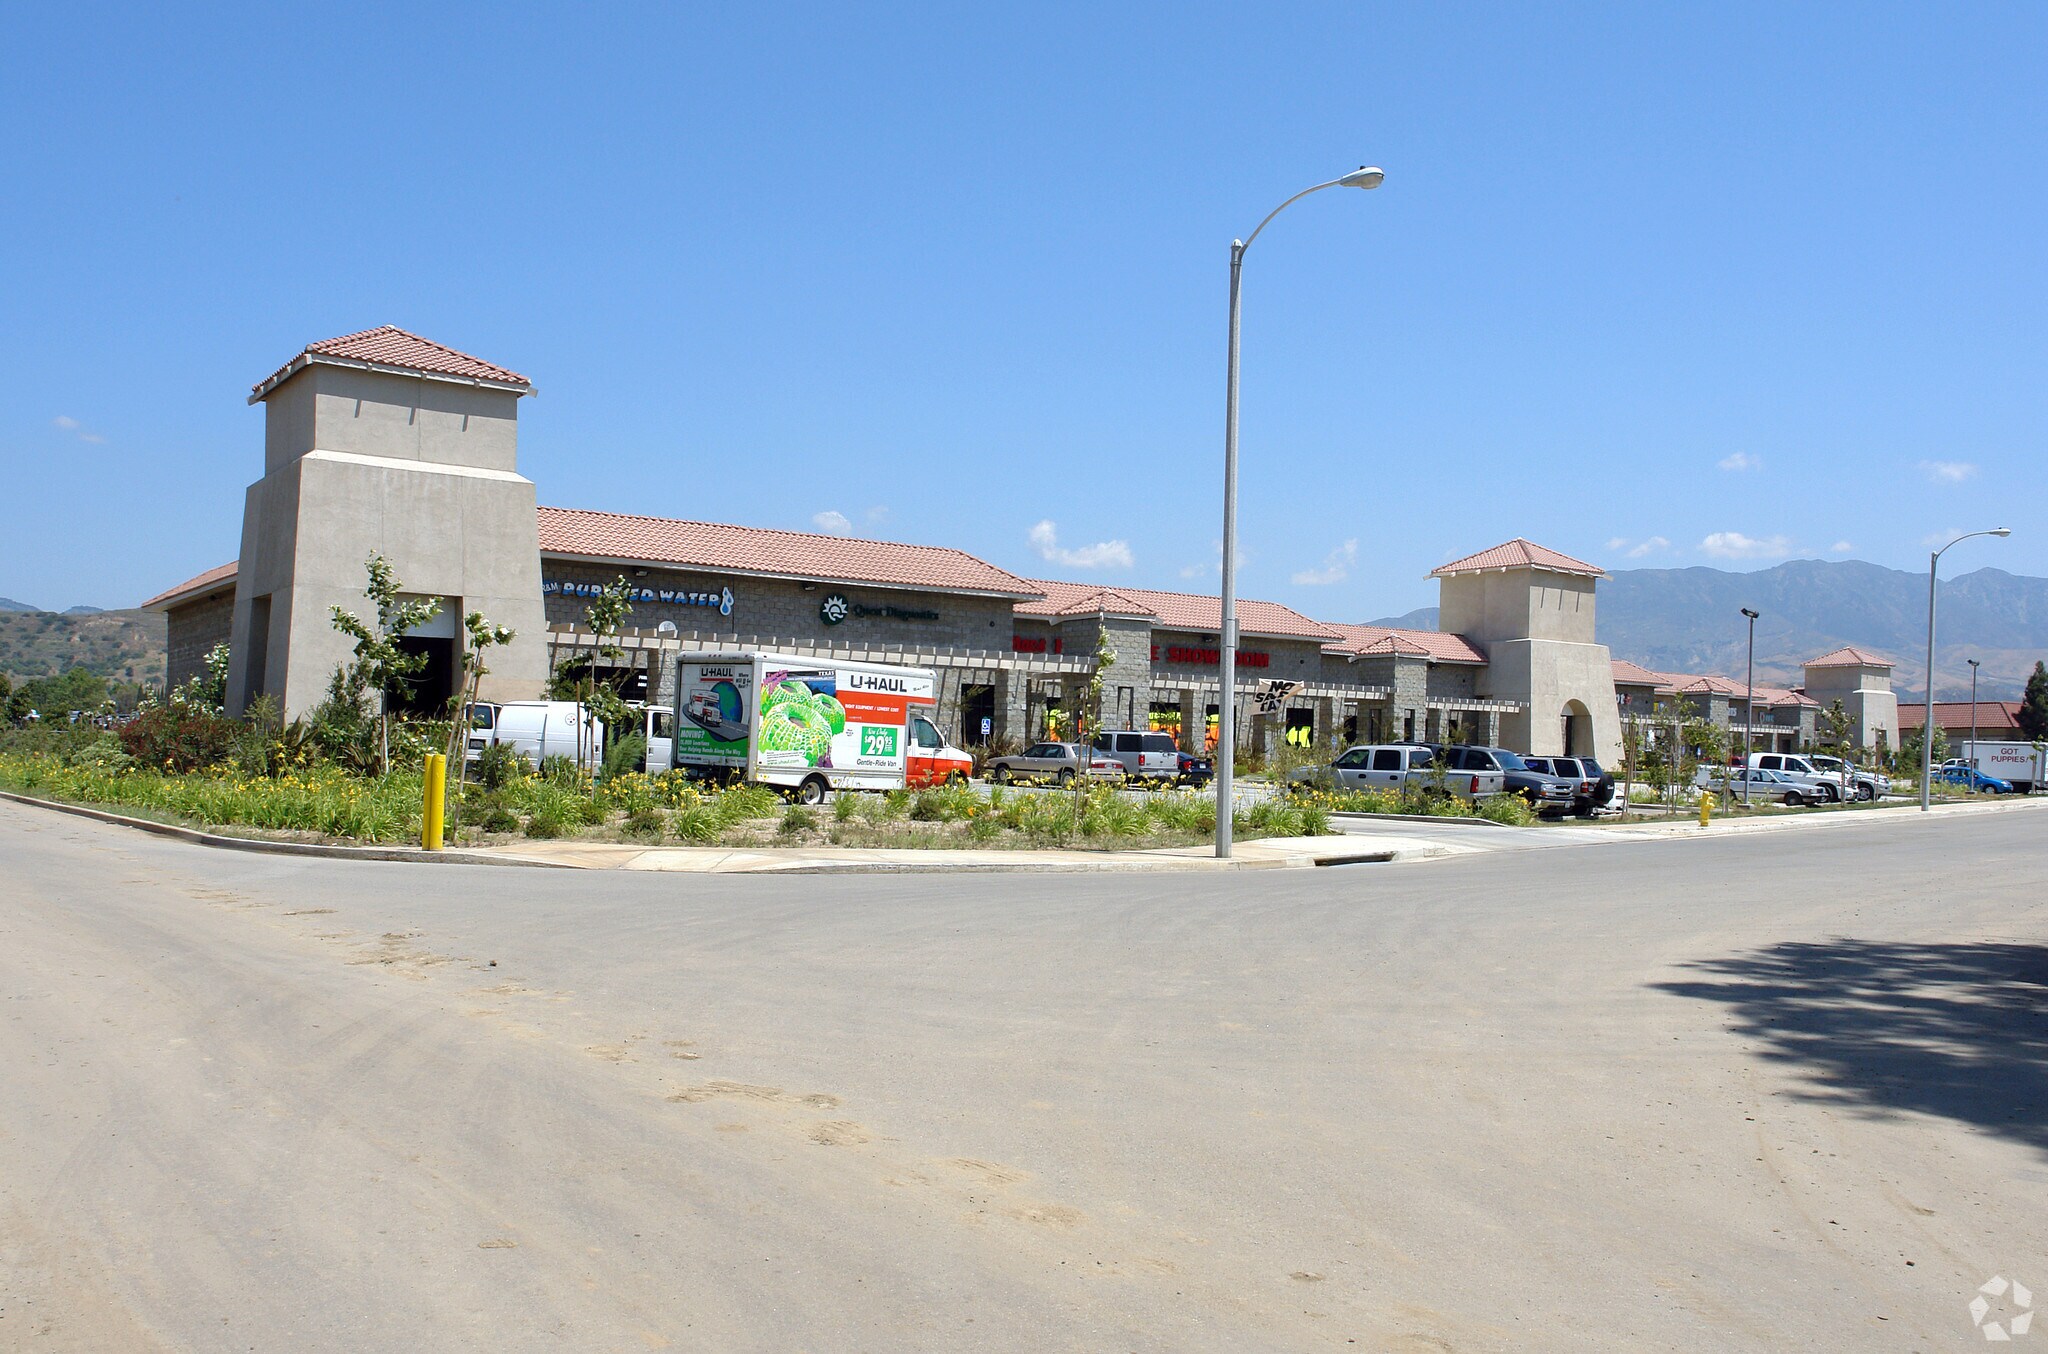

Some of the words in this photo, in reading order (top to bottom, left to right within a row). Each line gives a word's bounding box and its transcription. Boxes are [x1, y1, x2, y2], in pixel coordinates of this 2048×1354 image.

[659, 590, 719, 607] WATER
[1167, 647, 1271, 668] SHOWOOM
[701, 667, 733, 677] U-HAUL
[850, 675, 907, 692] U-HAUL
